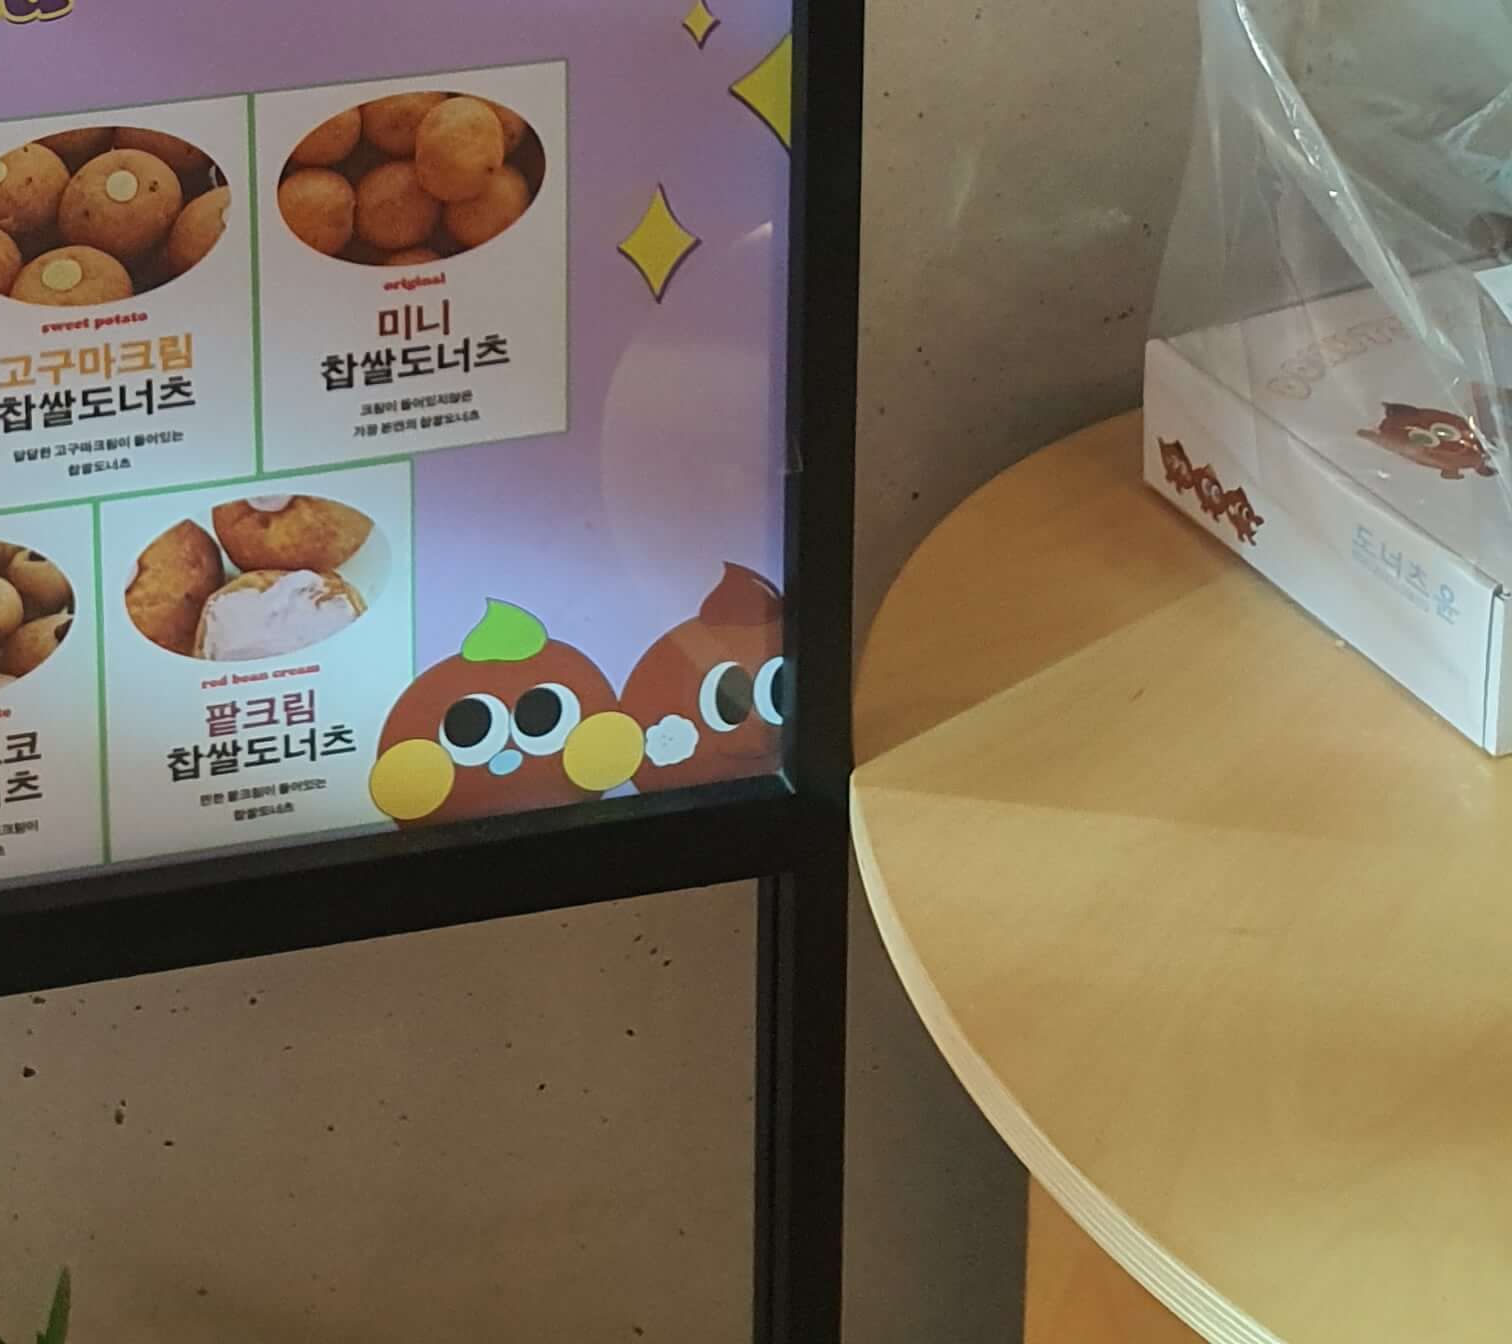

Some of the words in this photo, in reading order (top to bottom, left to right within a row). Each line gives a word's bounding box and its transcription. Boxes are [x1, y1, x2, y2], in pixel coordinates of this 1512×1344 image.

[383, 272, 447, 291] original
[41, 317, 89, 334] sweet
[94, 311, 148, 330] potato
[377, 298, 451, 341] 미니
[320, 332, 511, 391] 찹쌀도너츠
[205, 688, 316, 738] 팥크림
[166, 724, 358, 782] 찹쌀도너츠
